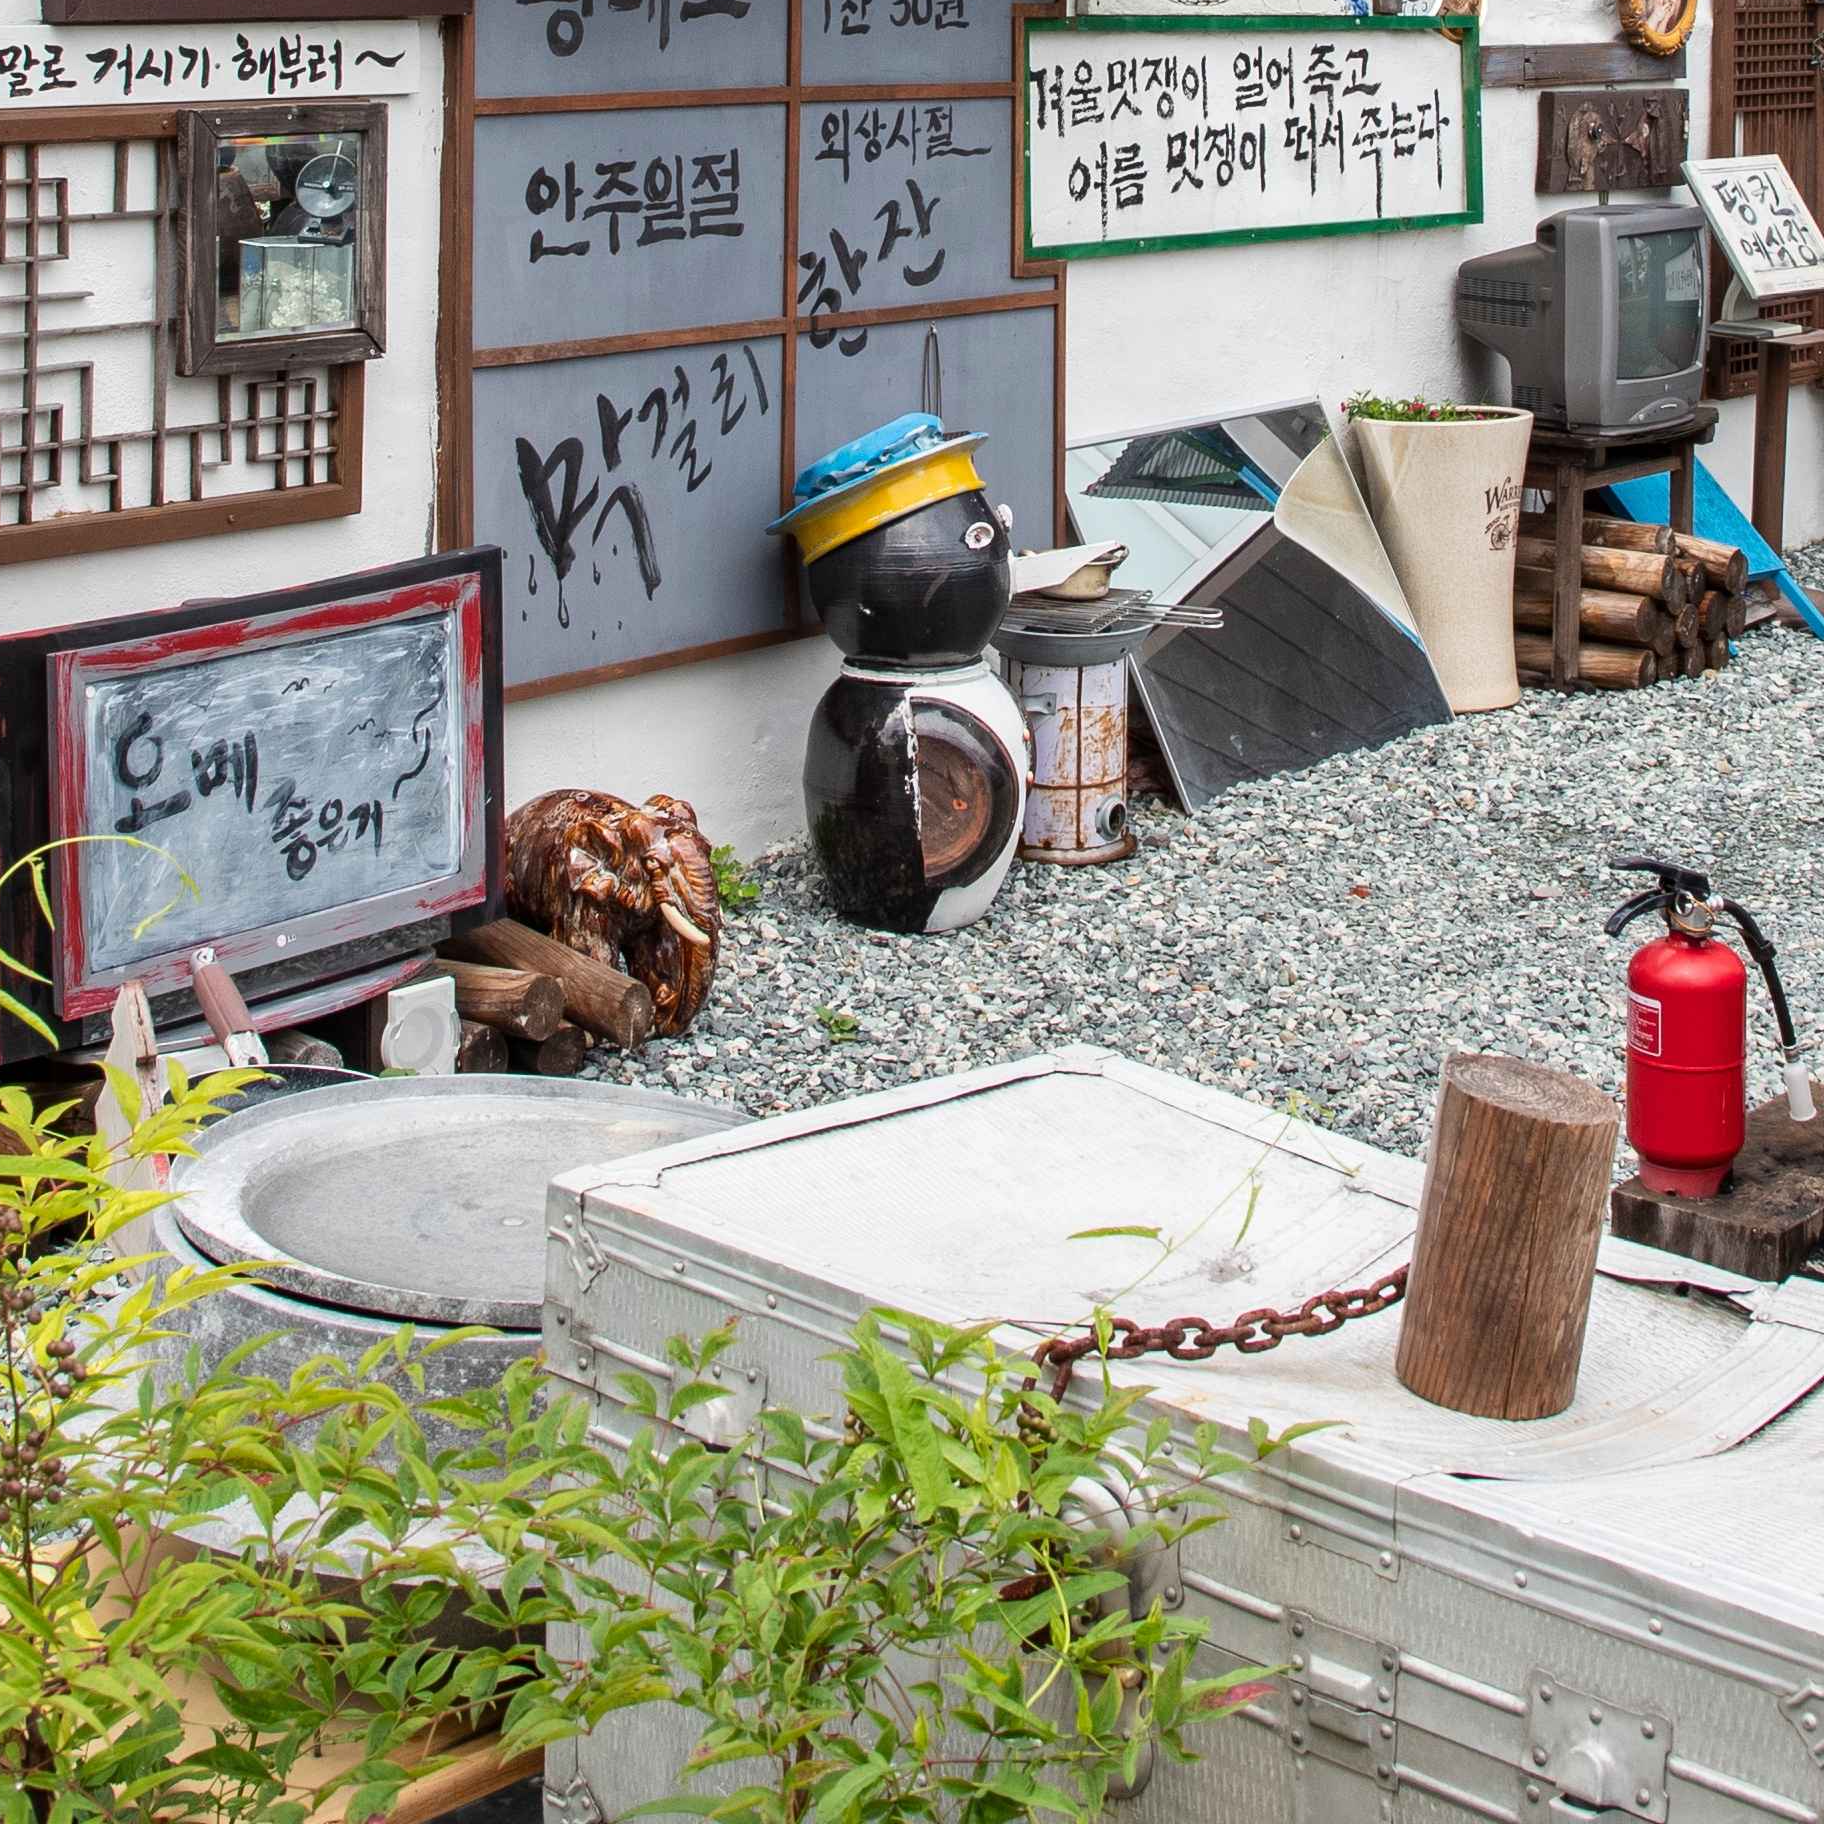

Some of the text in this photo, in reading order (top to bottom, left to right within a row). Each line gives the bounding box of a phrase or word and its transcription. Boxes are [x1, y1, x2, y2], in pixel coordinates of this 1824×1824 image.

[86, 43, 212, 95] 거시기
[1233, 45, 1295, 111] 얼어
[1303, 43, 1382, 115] 죽고
[816, 106, 993, 181] 외상사절
[1068, 140, 1148, 241] 여름
[1167, 123, 1266, 194] 멋쟁이
[523, 147, 746, 265] 안주일절
[514, 344, 768, 604] 막걸리
[114, 711, 258, 834] 오메
